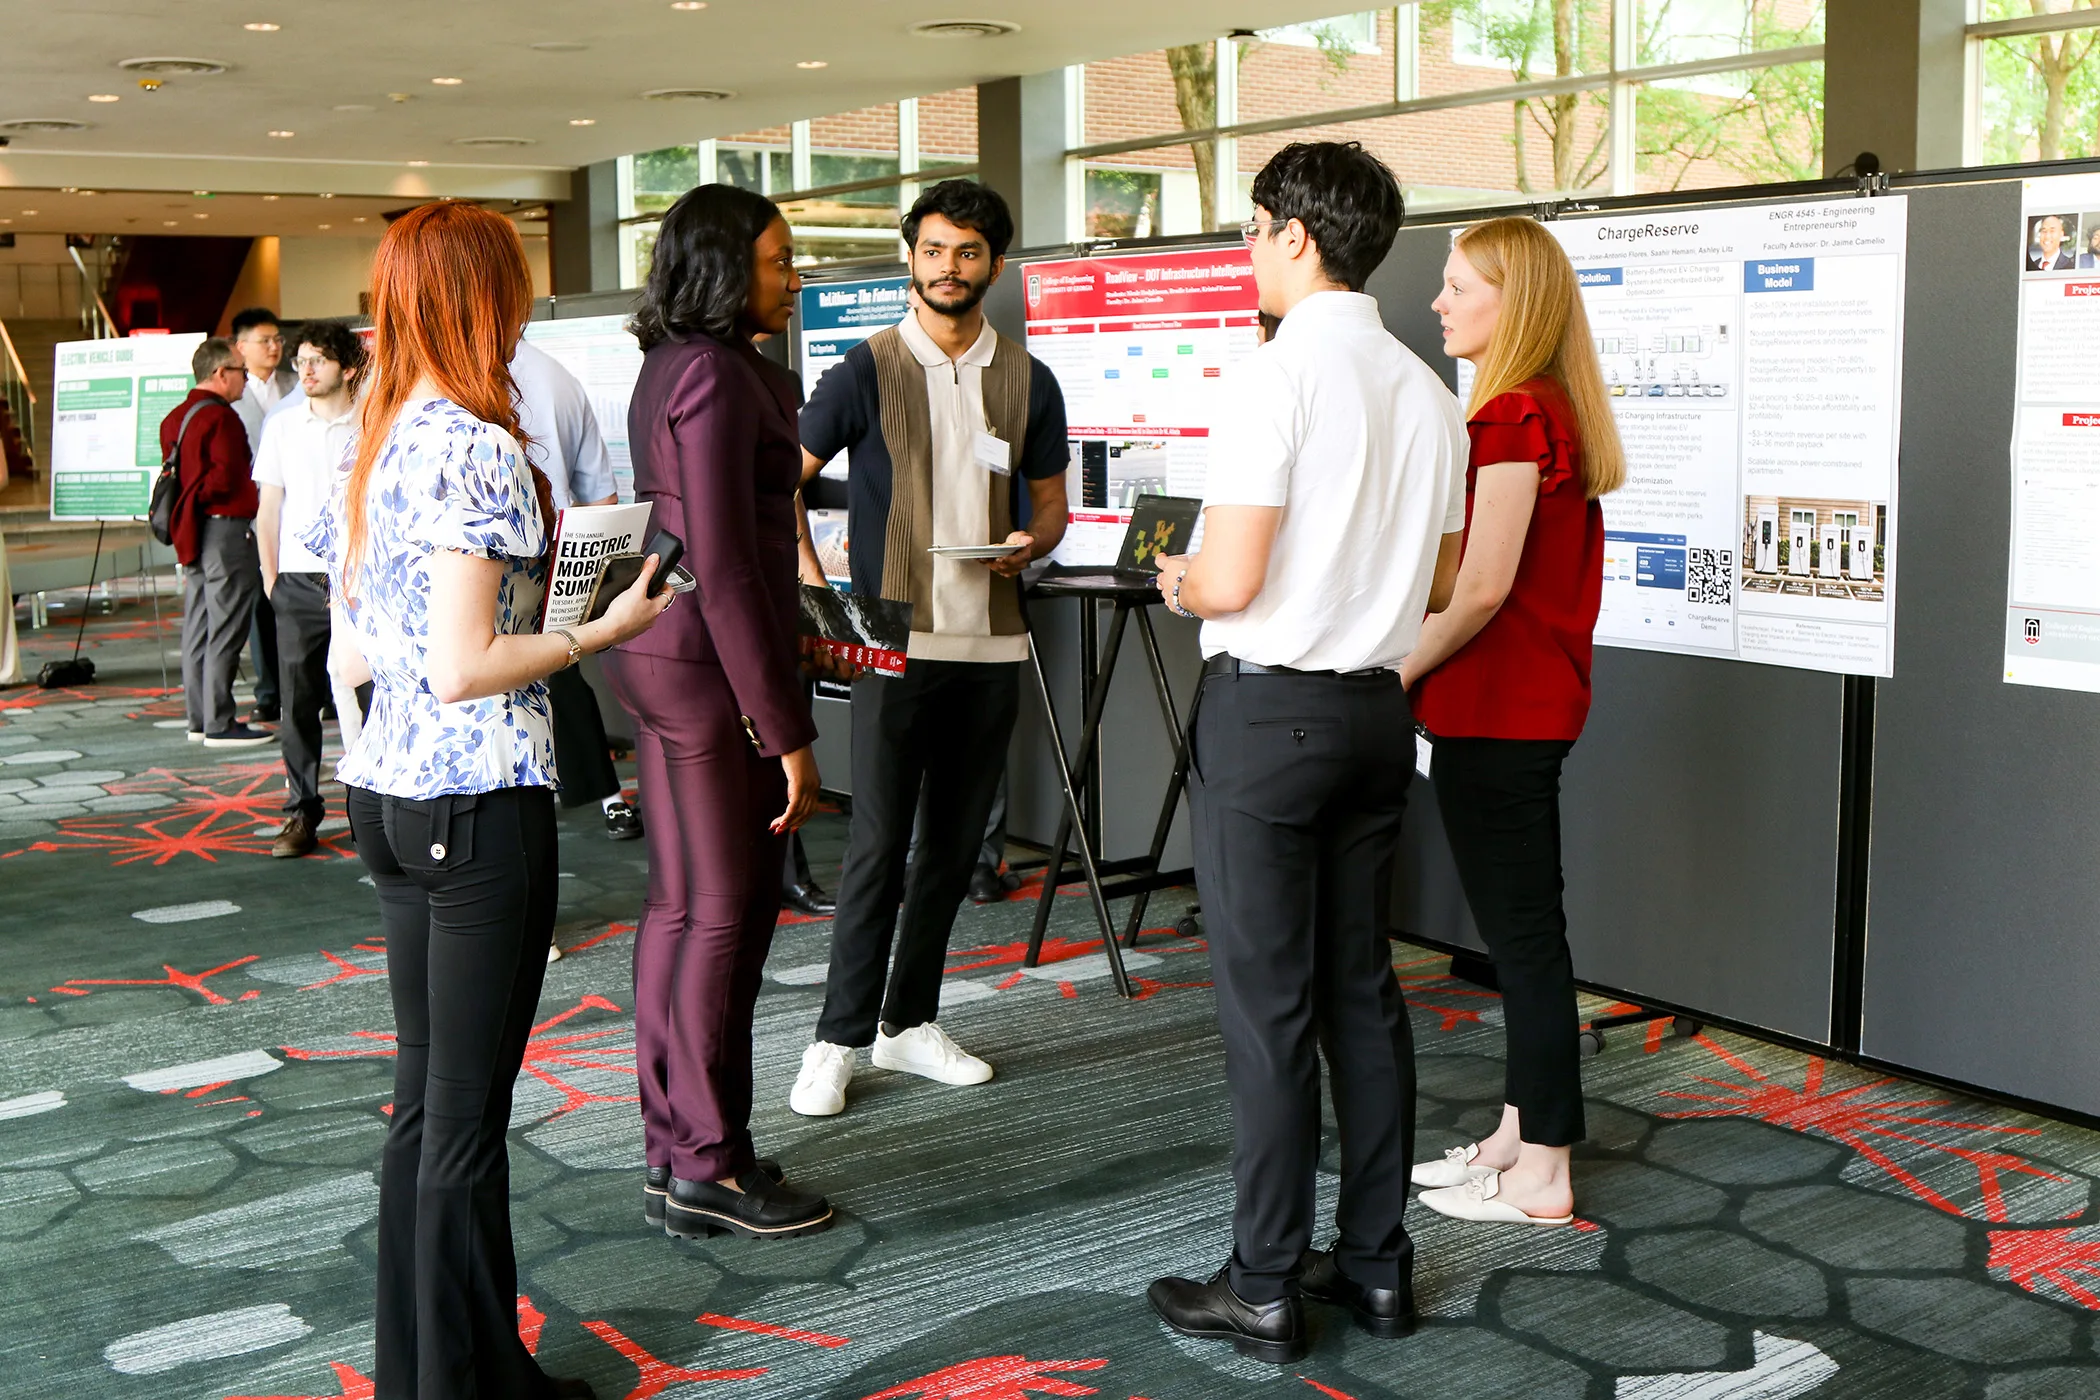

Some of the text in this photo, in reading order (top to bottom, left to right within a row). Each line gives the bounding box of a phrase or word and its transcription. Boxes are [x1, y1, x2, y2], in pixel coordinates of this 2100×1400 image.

[1769, 210, 1794, 221] ENGR
[1796, 208, 1816, 219] 4545
[1823, 204, 1875, 218] Engineering
[1783, 219, 1857, 233] Entrepreneurship
[1597, 223, 1700, 242] ChargeReserve
[1763, 236, 1886, 252] Faculty Advisor: Dr. Jaime Camelio
[1698, 246, 1720, 256] Ashley
[1105, 263, 1254, 285] RoadView DOT Infrastructure Intelligence
[1625, 266, 1678, 276] Battery-Buffered
[1689, 265, 1720, 275] Charging
[1757, 263, 1800, 276] Business
[1579, 273, 1611, 284] Solution
[1625, 278, 1649, 288] System
[1663, 276, 1703, 285] Incentivized
[1704, 275, 1725, 285] Usage
[1764, 276, 1793, 289] Model
[857, 288, 872, 305] The
[872, 287, 898, 304] Future
[1625, 287, 1666, 298] Optimization
[1776, 328, 1816, 338] deployment
[1828, 327, 1857, 337] property
[1749, 337, 1802, 348] ChargeReserve
[1822, 336, 1837, 346] and
[1837, 336, 1868, 347] operates
[1749, 364, 1801, 376] ChargeReserve
[1748, 393, 1765, 402] User
[1793, 402, 1820, 412] balance
[1820, 403, 1861, 413] affordability
[1861, 404, 1876, 413] and
[1624, 411, 1655, 422] Charging
[1655, 411, 1702, 421] Infrastructure
[1748, 411, 1784, 422] profitability
[1690, 435, 1702, 443] and
[1796, 431, 1825, 440] revenue
[1677, 443, 1702, 454] charging
[1747, 455, 1863, 470] Scalable across power-constrained
[1747, 466, 1784, 478] apartments
[1631, 475, 1674, 487] Optimization
[564, 531, 575, 539] THE
[575, 531, 586, 540] 5TH
[560, 533, 632, 559] ELECTRIC
[557, 559, 601, 577] MOBI
[1687, 613, 1730, 625] ChargeReserve
[1700, 622, 1717, 632] Demo
